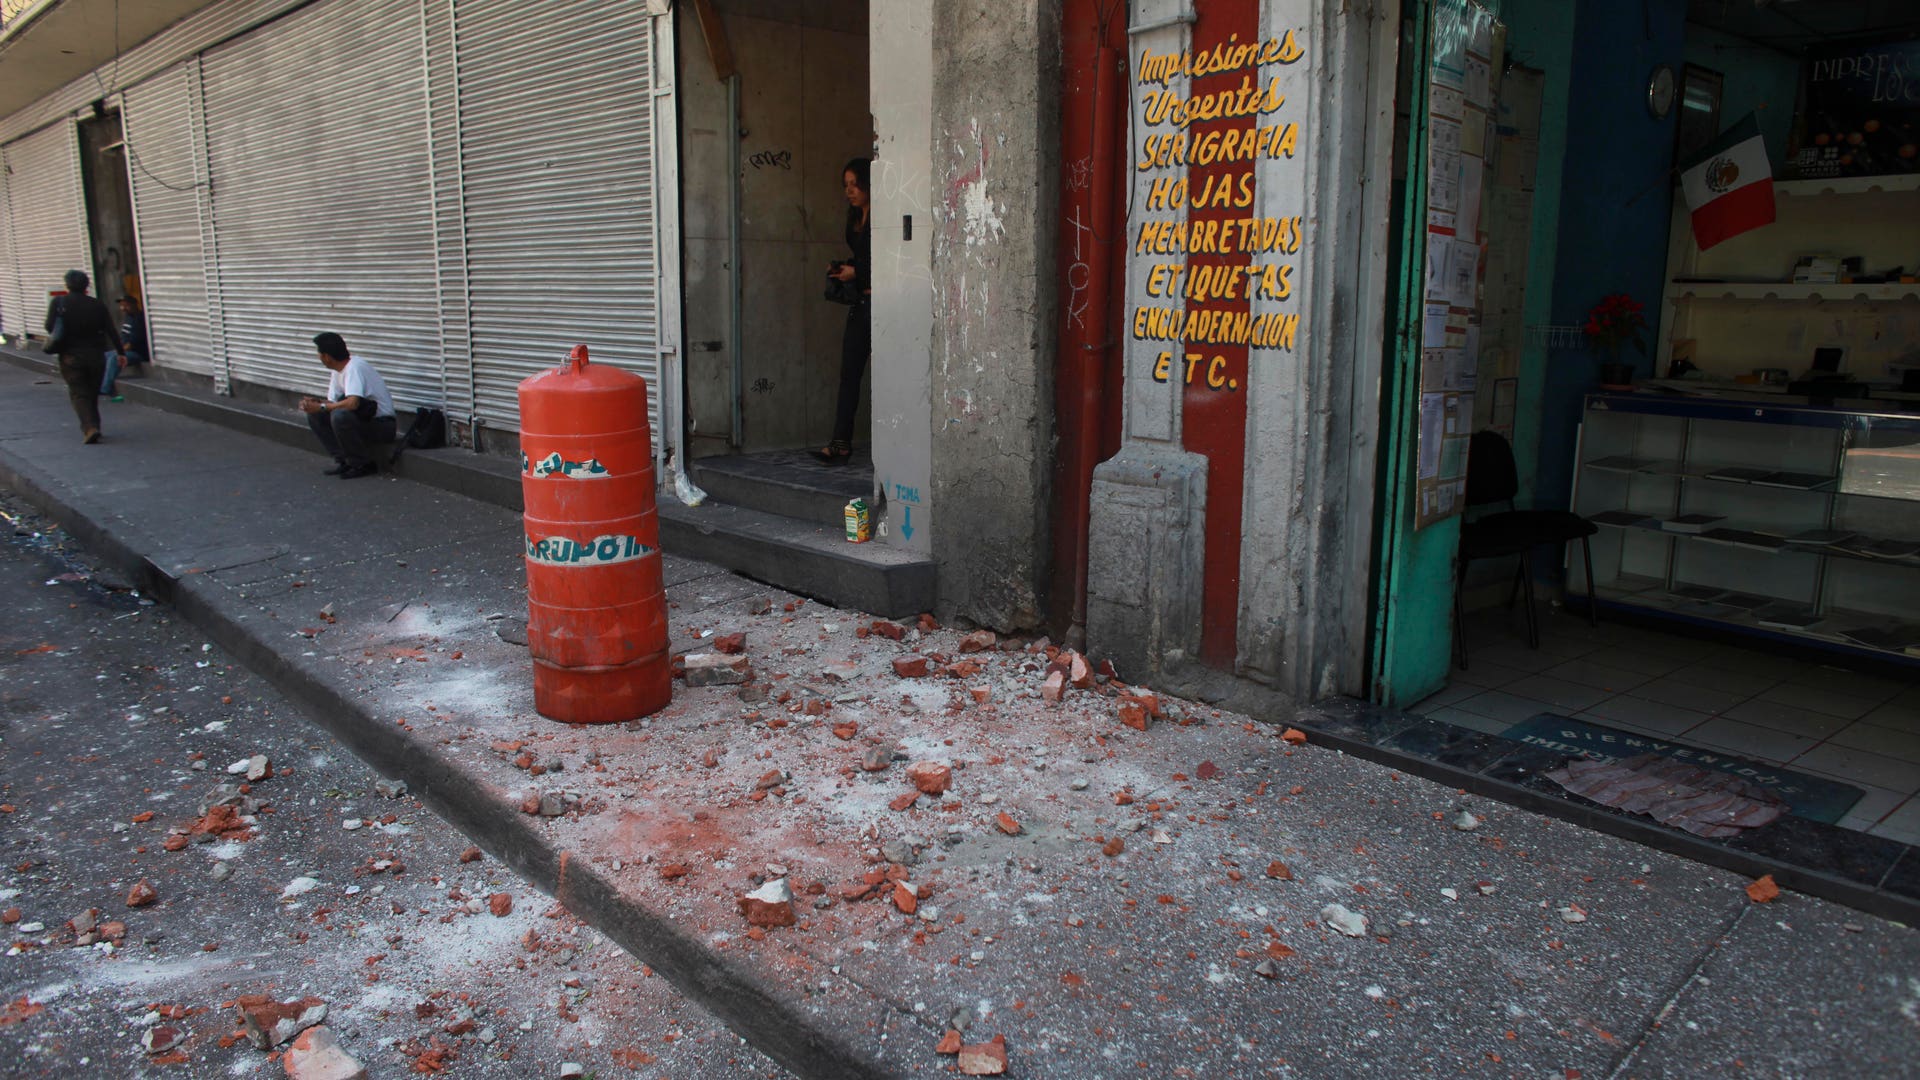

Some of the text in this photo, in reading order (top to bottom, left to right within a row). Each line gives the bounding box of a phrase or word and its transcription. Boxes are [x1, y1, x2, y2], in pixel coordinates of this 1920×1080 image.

[1138, 29, 1305, 88] Impresiones
[1142, 75, 1286, 131] Urgentes
[1138, 122, 1299, 172] SERIGRAFIA
[1145, 172, 1255, 211] HOJAS
[1136, 216, 1302, 256] MEMBRETADAS
[1146, 263, 1293, 303] ETIQUETAS
[1133, 306, 1300, 352] ENCUADERNACION
[527, 536, 620, 562] GRUPO
